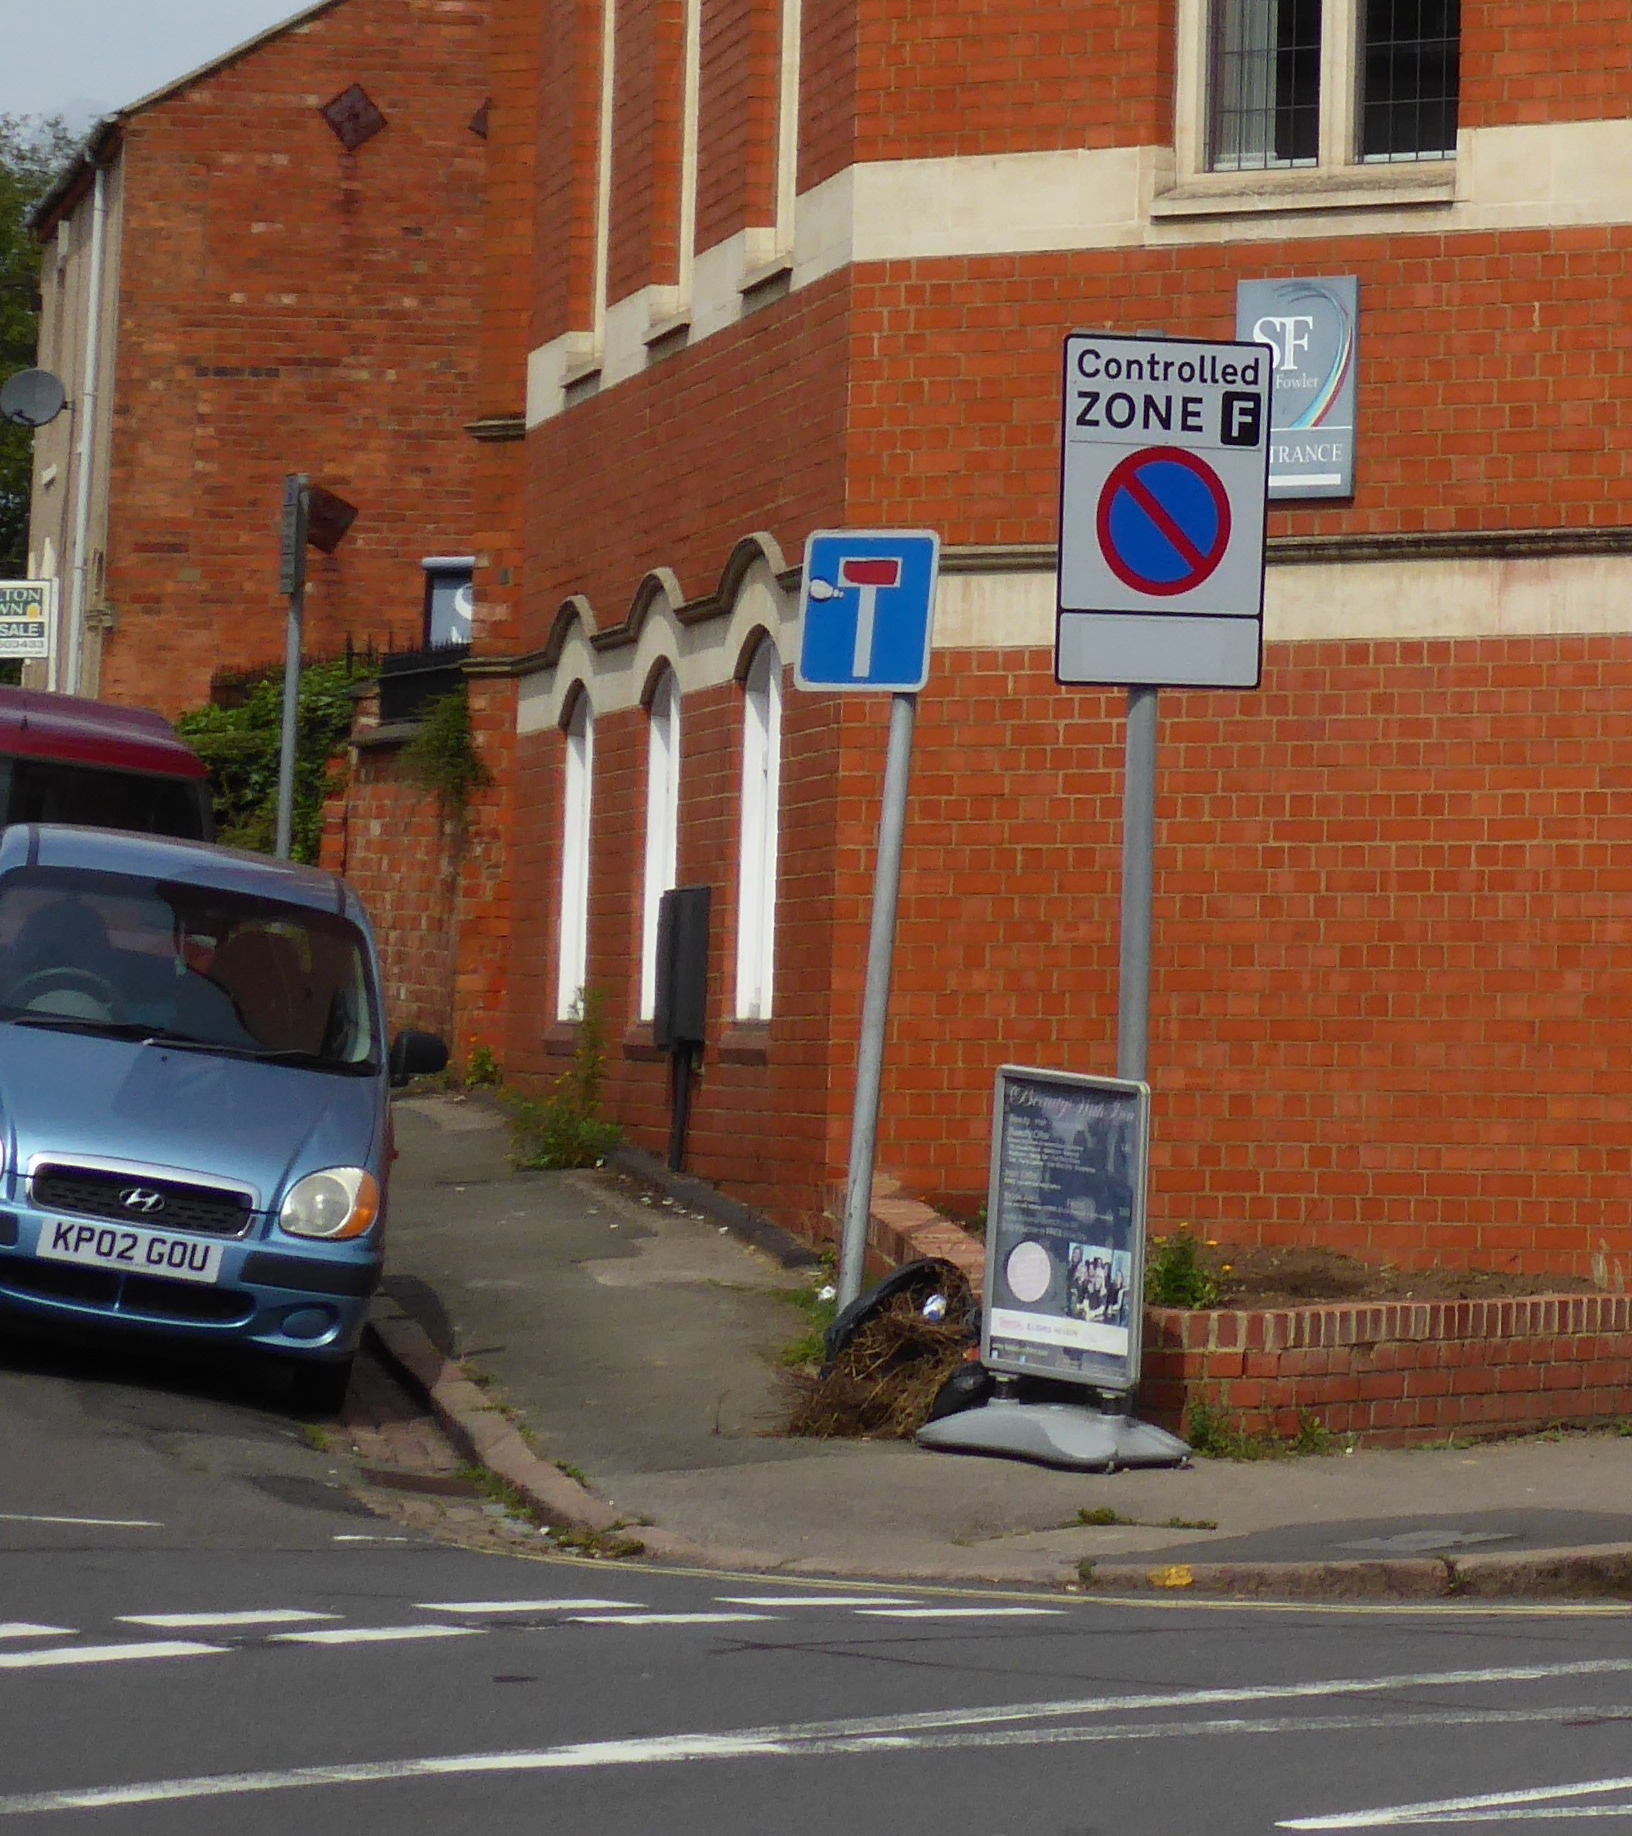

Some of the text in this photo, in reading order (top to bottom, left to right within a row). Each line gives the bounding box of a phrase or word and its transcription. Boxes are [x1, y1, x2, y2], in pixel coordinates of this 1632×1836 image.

[1252, 315, 1314, 371] SF
[1077, 349, 1260, 386] Controlled
[1275, 373, 1320, 390] Fowler
[1076, 390, 1256, 438] ZONE F
[52, 1221, 138, 1258] KP02
[146, 1237, 211, 1272] GOU
